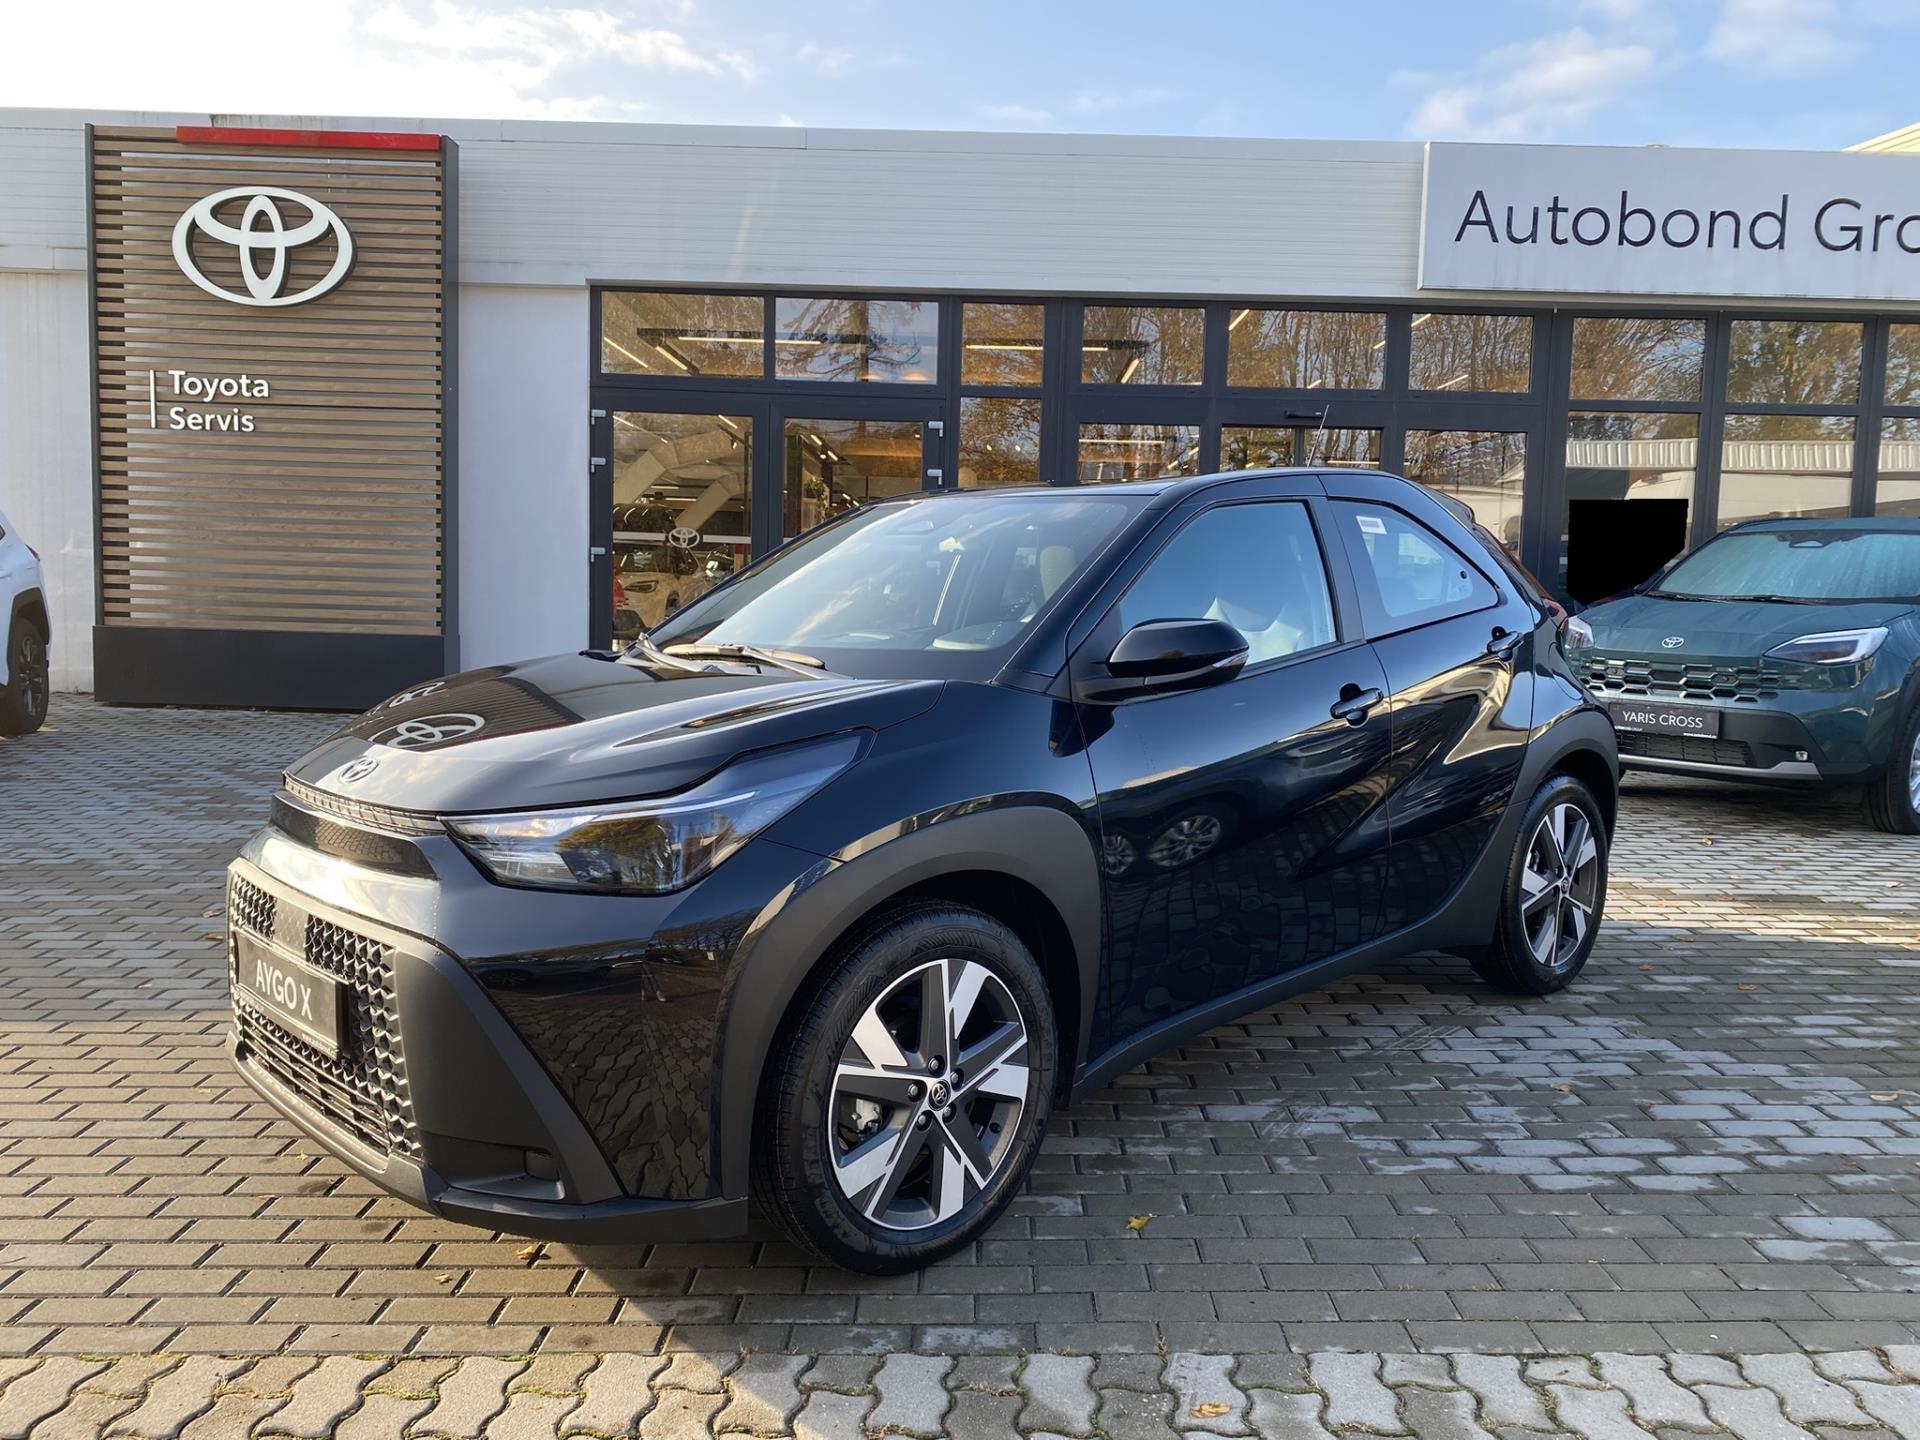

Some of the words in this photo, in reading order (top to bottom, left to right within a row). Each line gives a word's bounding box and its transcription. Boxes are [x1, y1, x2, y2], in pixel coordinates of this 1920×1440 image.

[1453, 189, 1790, 251] Autobond
[167, 369, 270, 402] Toyota
[169, 406, 255, 432] Servis
[1622, 710, 1656, 725] YARIS
[1659, 713, 1703, 729] CROSS
[255, 959, 298, 1010] AYGO
[300, 983, 313, 1021] X
